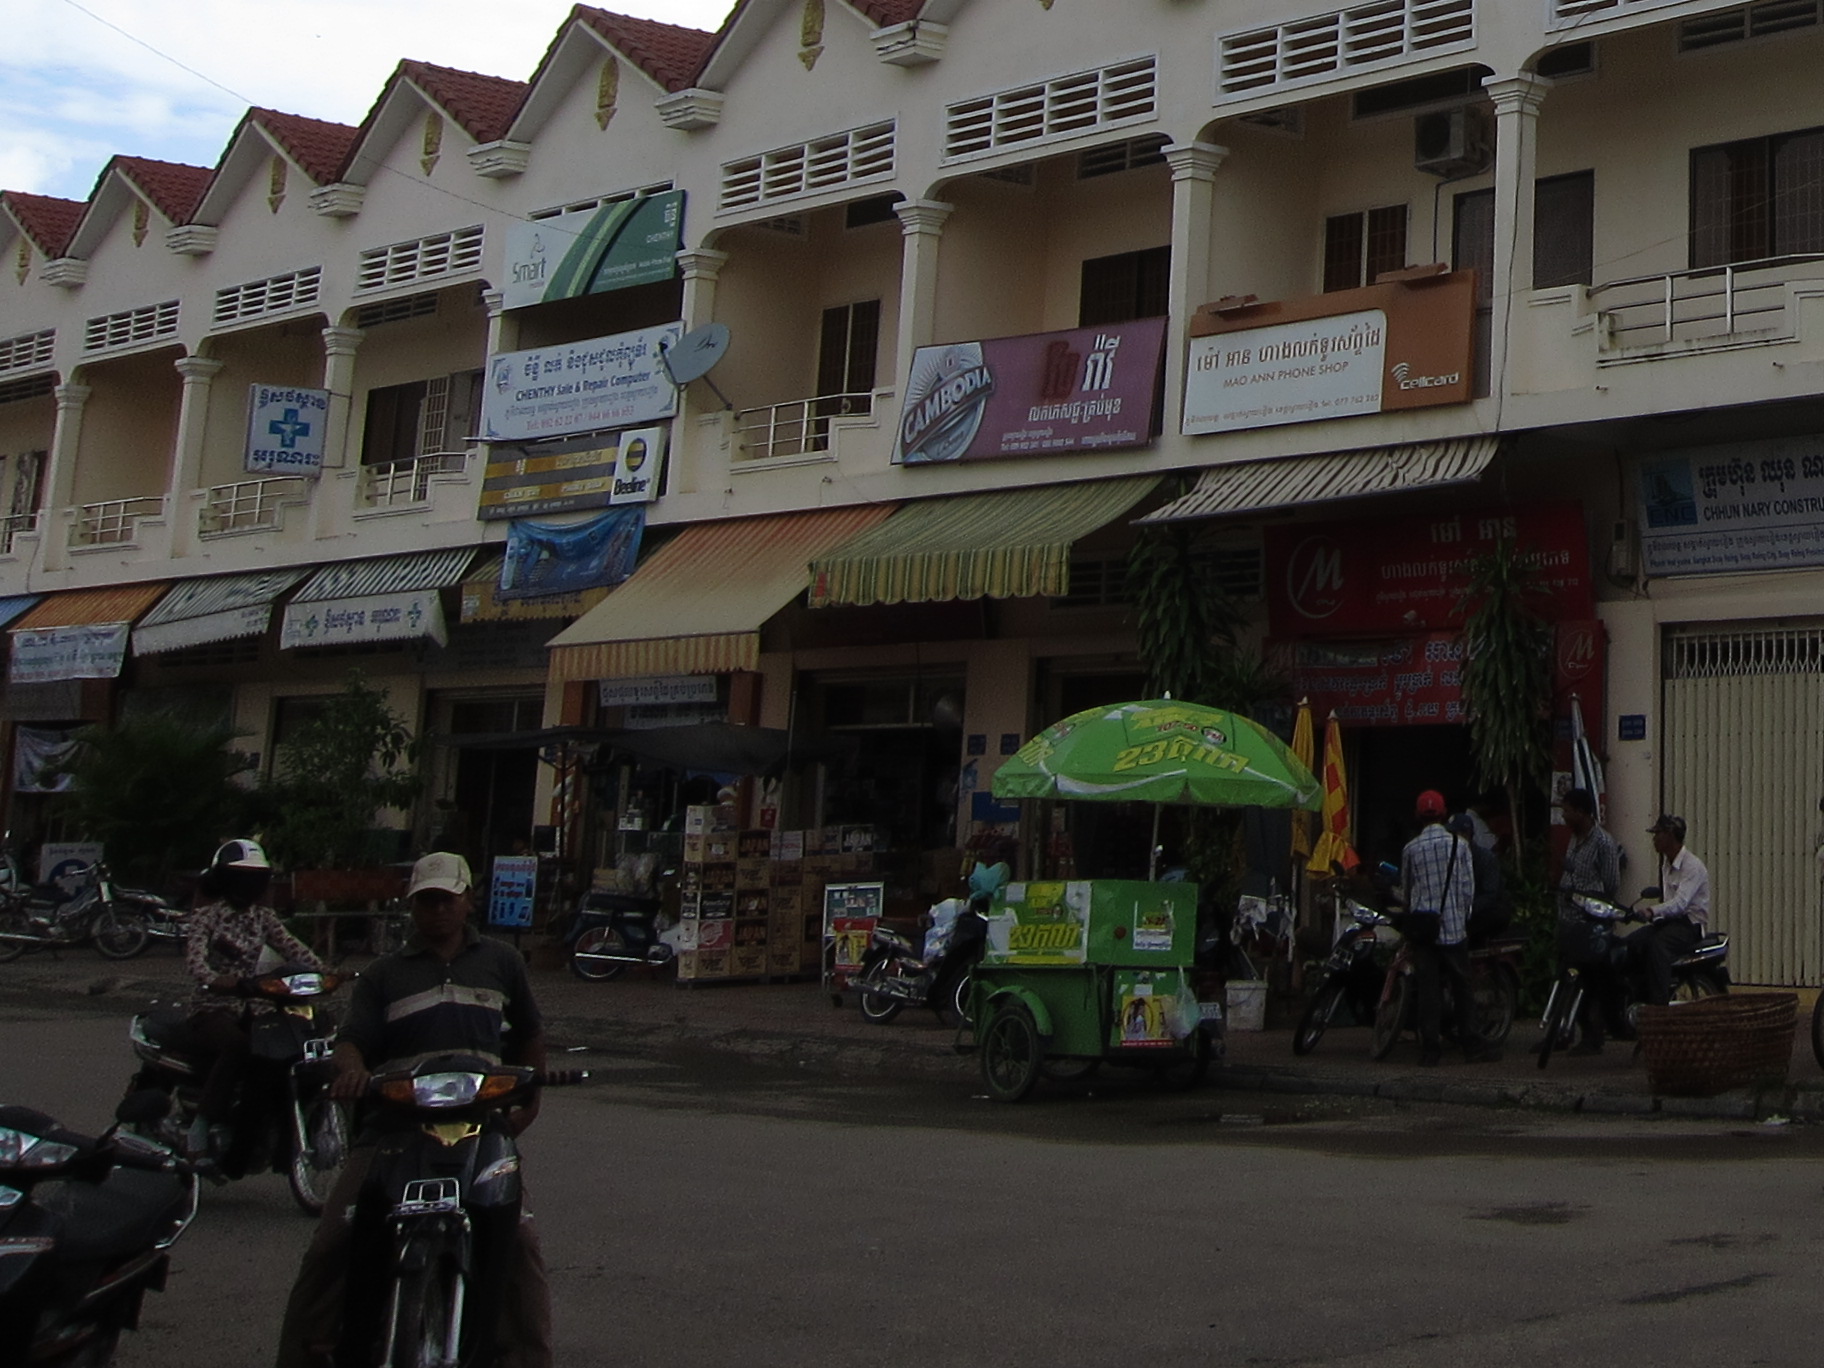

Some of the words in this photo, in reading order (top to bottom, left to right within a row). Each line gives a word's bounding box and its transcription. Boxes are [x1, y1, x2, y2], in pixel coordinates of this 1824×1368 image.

[512, 257, 547, 283] Smart
[1225, 348, 1252, 369] អាន
[1222, 375, 1248, 389] MAO
[1250, 371, 1277, 385] ANN
[1278, 367, 1316, 382] PHONE
[1318, 361, 1350, 376] SHOP
[1399, 370, 1460, 391] cellcard
[515, 384, 556, 402] CHENTHY
[574, 381, 581, 393] &
[582, 377, 609, 394] Repair
[610, 370, 652, 388] Computer
[903, 364, 993, 445] CAMBODIA
[613, 476, 647, 496] Beeline
[1650, 505, 1694, 524] CNC
[1703, 505, 1740, 522] CHHUN
[1742, 503, 1771, 520] NARY
